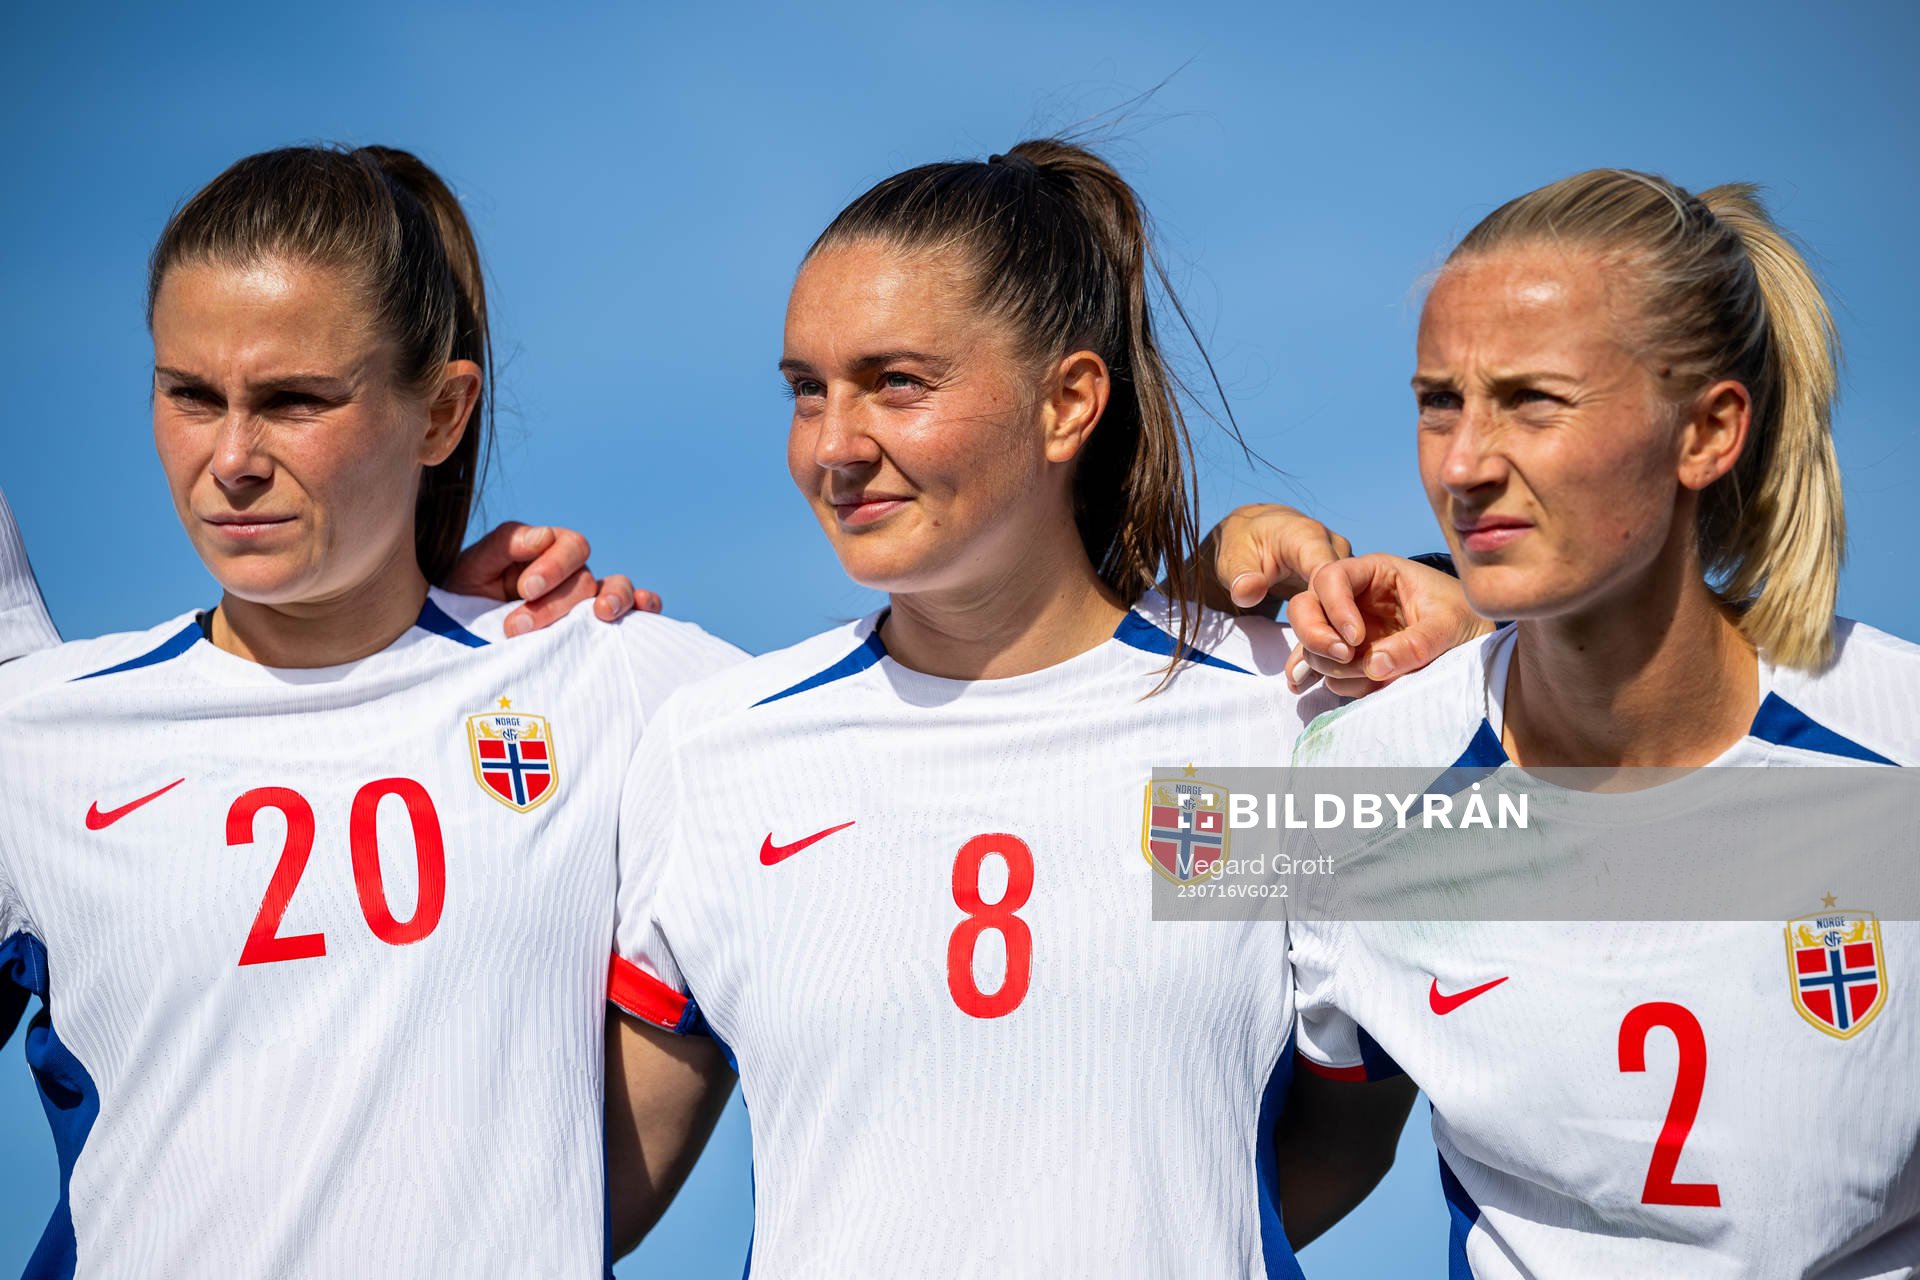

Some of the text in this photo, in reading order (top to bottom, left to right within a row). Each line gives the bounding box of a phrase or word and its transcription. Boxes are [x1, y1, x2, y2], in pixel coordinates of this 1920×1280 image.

[495, 717, 520, 726] NORGE
[1175, 784, 1202, 796] NORGE
[226, 777, 445, 966] 20
[947, 832, 1034, 1018] 8
[1816, 916, 1846, 929] NORGE
[1617, 1001, 1721, 1207] 2
